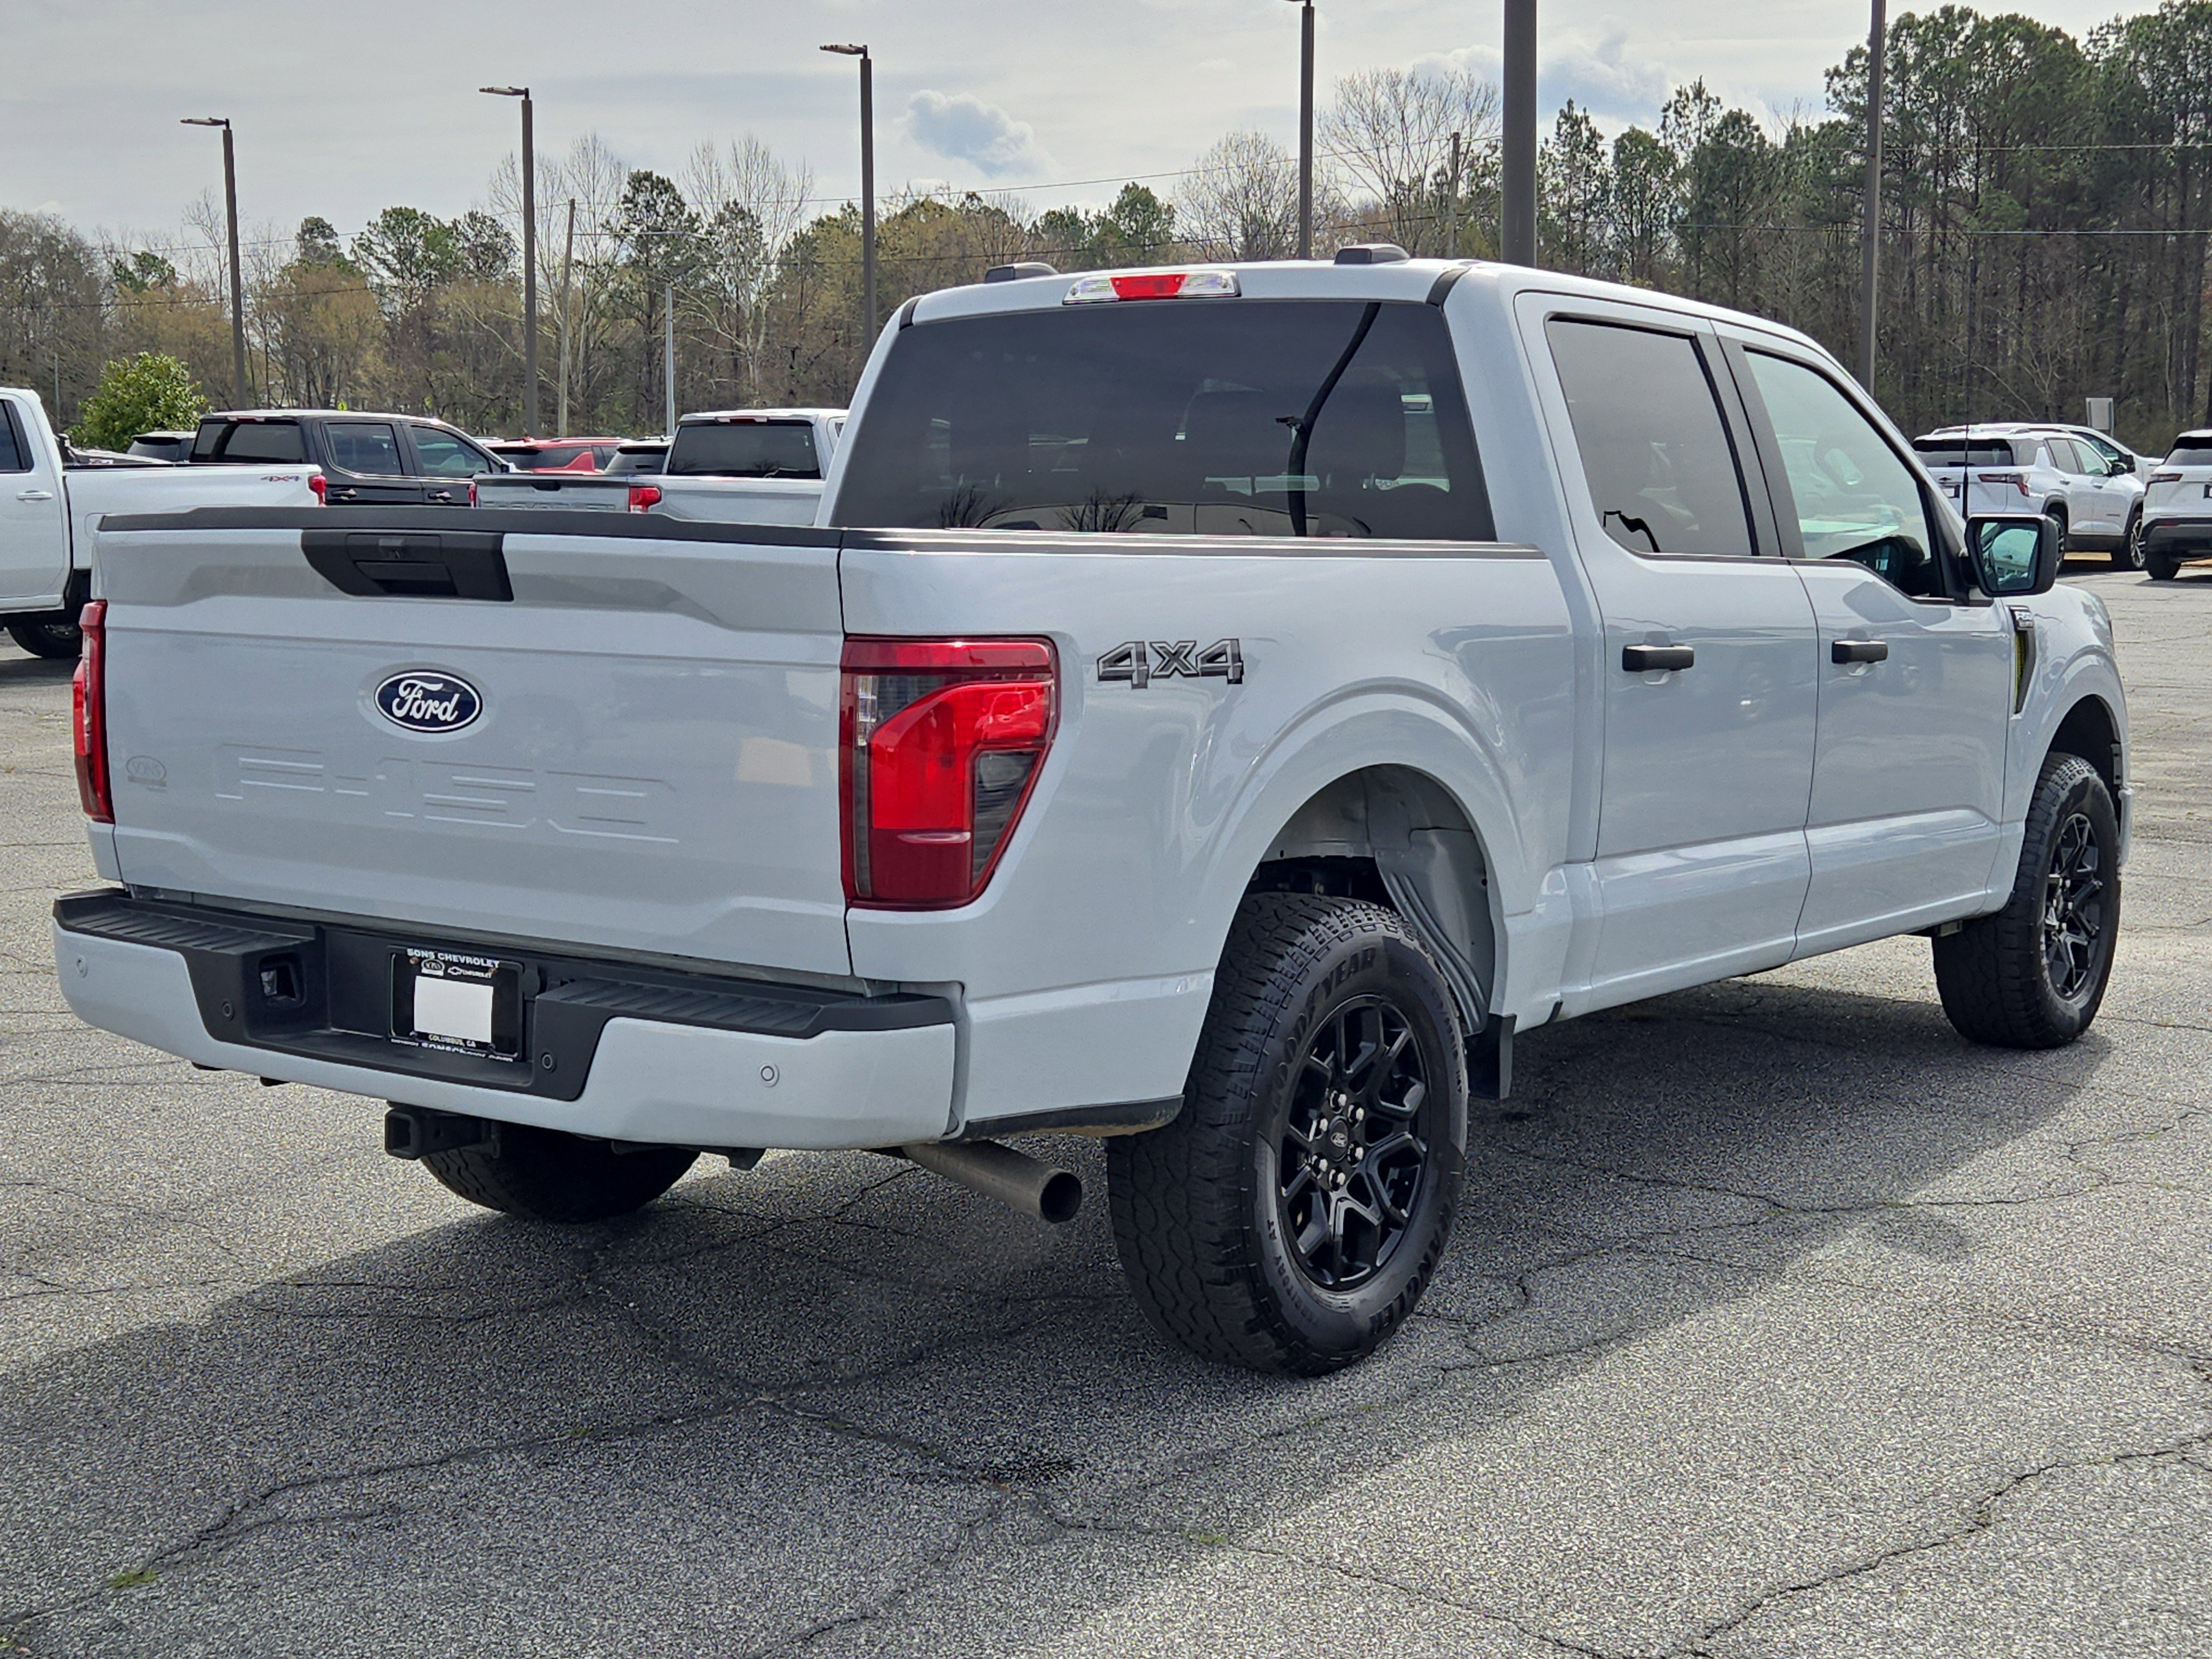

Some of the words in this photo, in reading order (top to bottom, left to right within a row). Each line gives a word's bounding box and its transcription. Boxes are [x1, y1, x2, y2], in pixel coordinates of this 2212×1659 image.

[1097, 638, 1244, 689] 4X4
[392, 679, 460, 722] Ford
[407, 948, 435, 959] SONS
[438, 952, 500, 968] CHEVROLET
